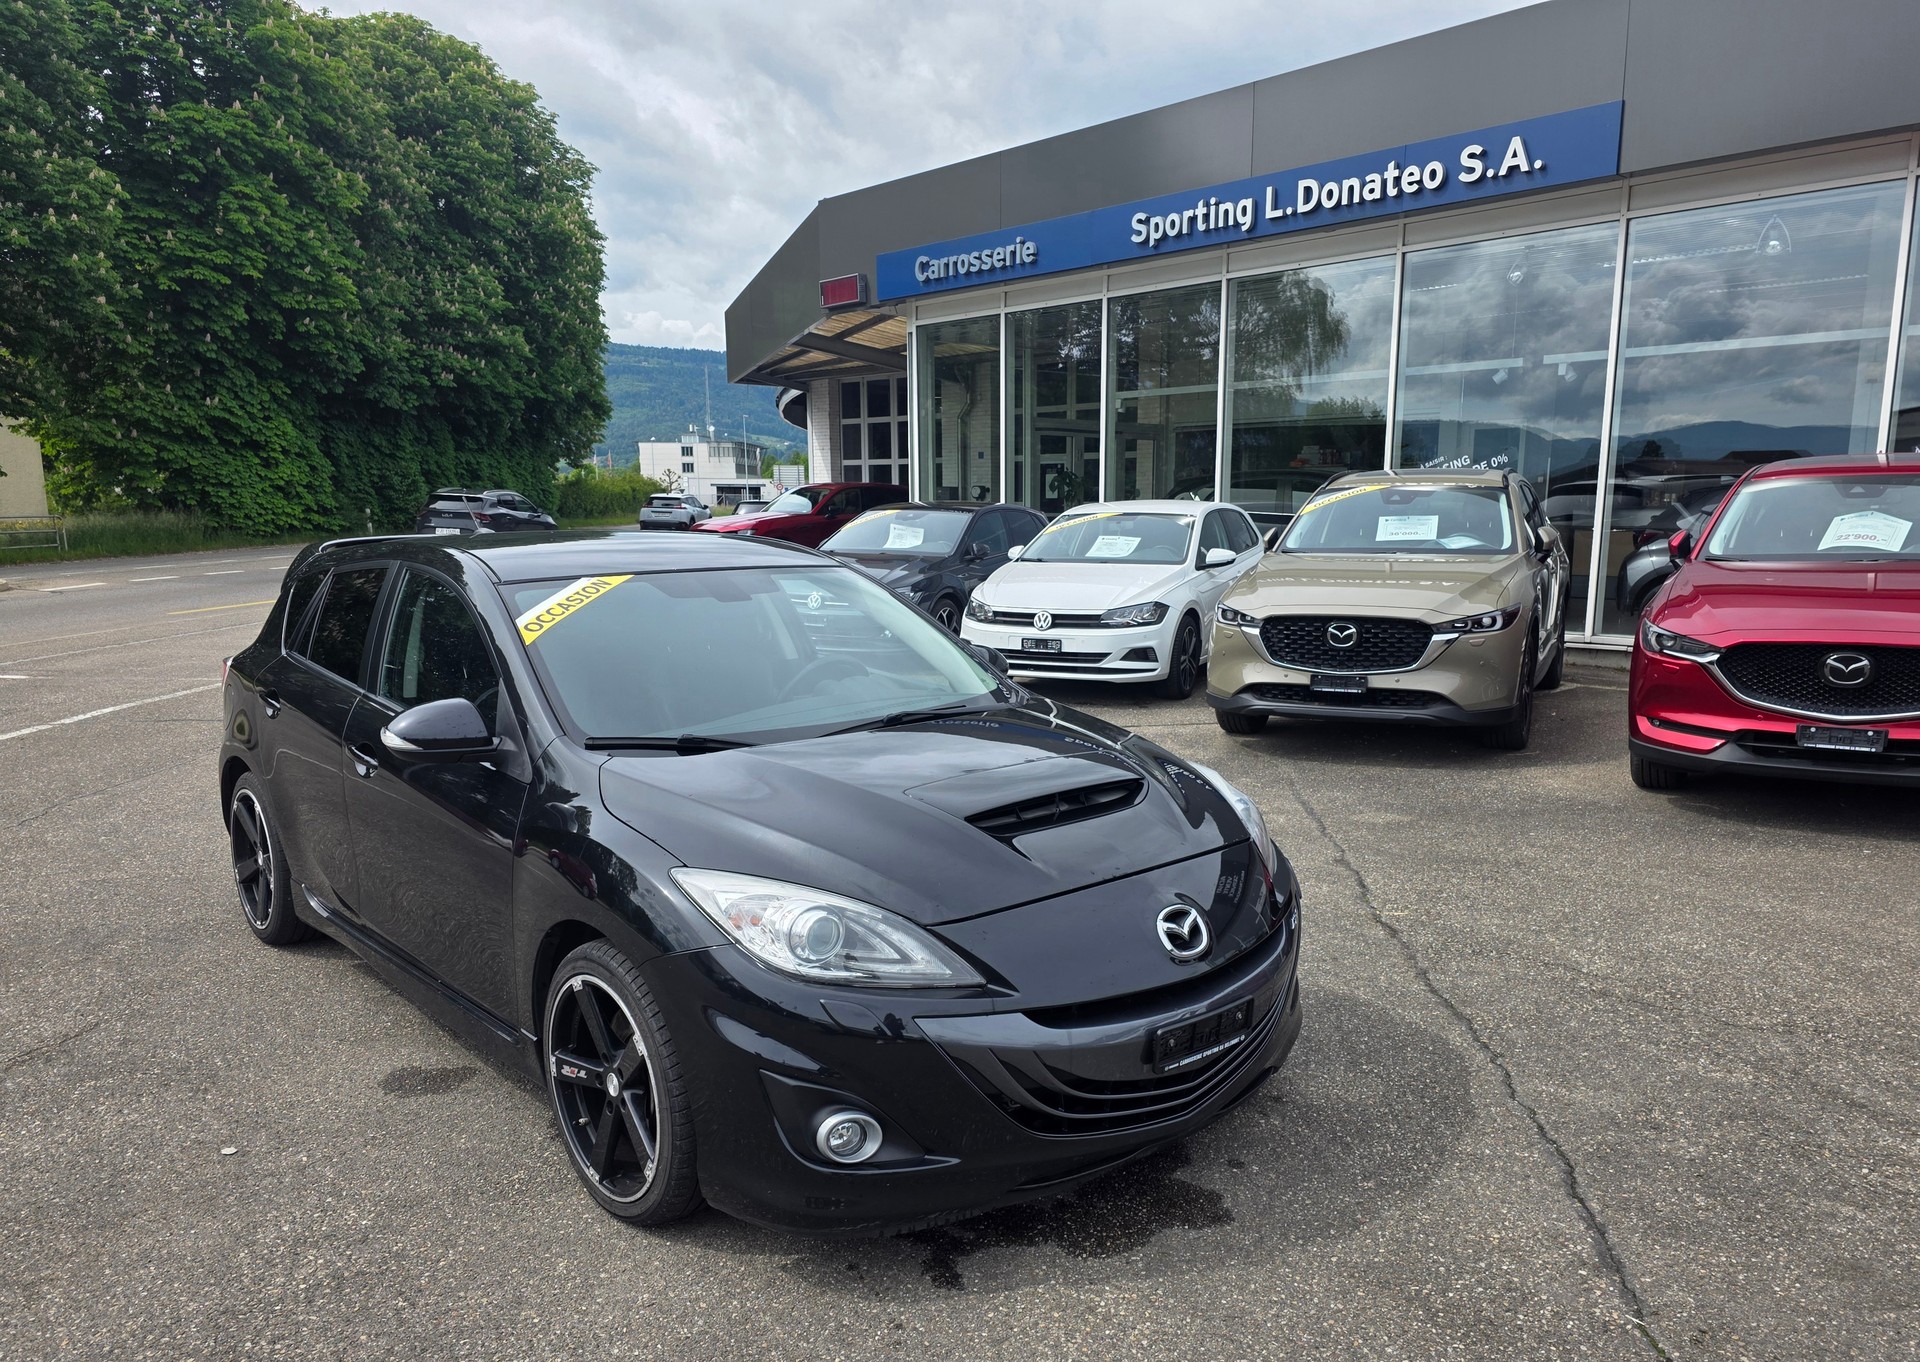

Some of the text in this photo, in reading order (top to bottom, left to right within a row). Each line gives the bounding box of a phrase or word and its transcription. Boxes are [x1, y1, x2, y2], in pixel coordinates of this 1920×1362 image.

[1130, 196, 1256, 248] Sporting
[1457, 135, 1546, 184] S.A.
[914, 236, 1038, 282] Carrosserie
[1490, 453, 1509, 468] 0%
[522, 579, 613, 633] OCCASION
